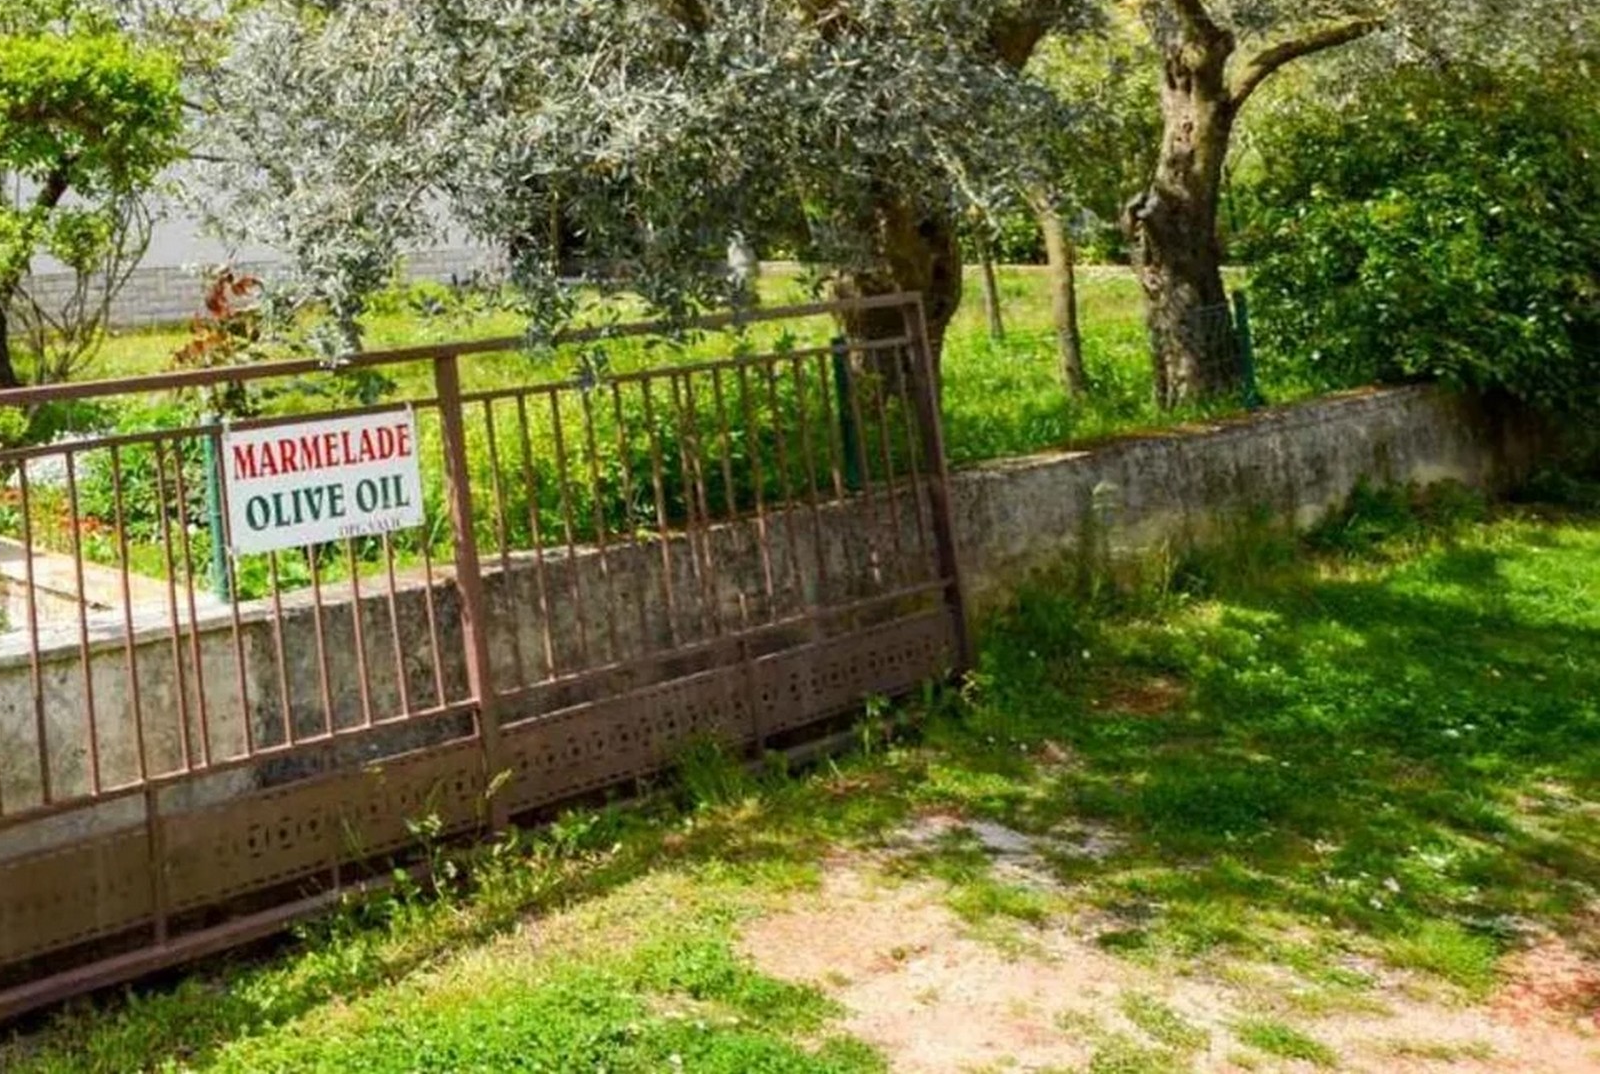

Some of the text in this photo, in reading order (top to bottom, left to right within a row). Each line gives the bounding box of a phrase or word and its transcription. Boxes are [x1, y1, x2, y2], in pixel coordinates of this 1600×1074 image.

[233, 424, 411, 480] MARMELADE
[246, 475, 410, 531] OLIVE OIL
